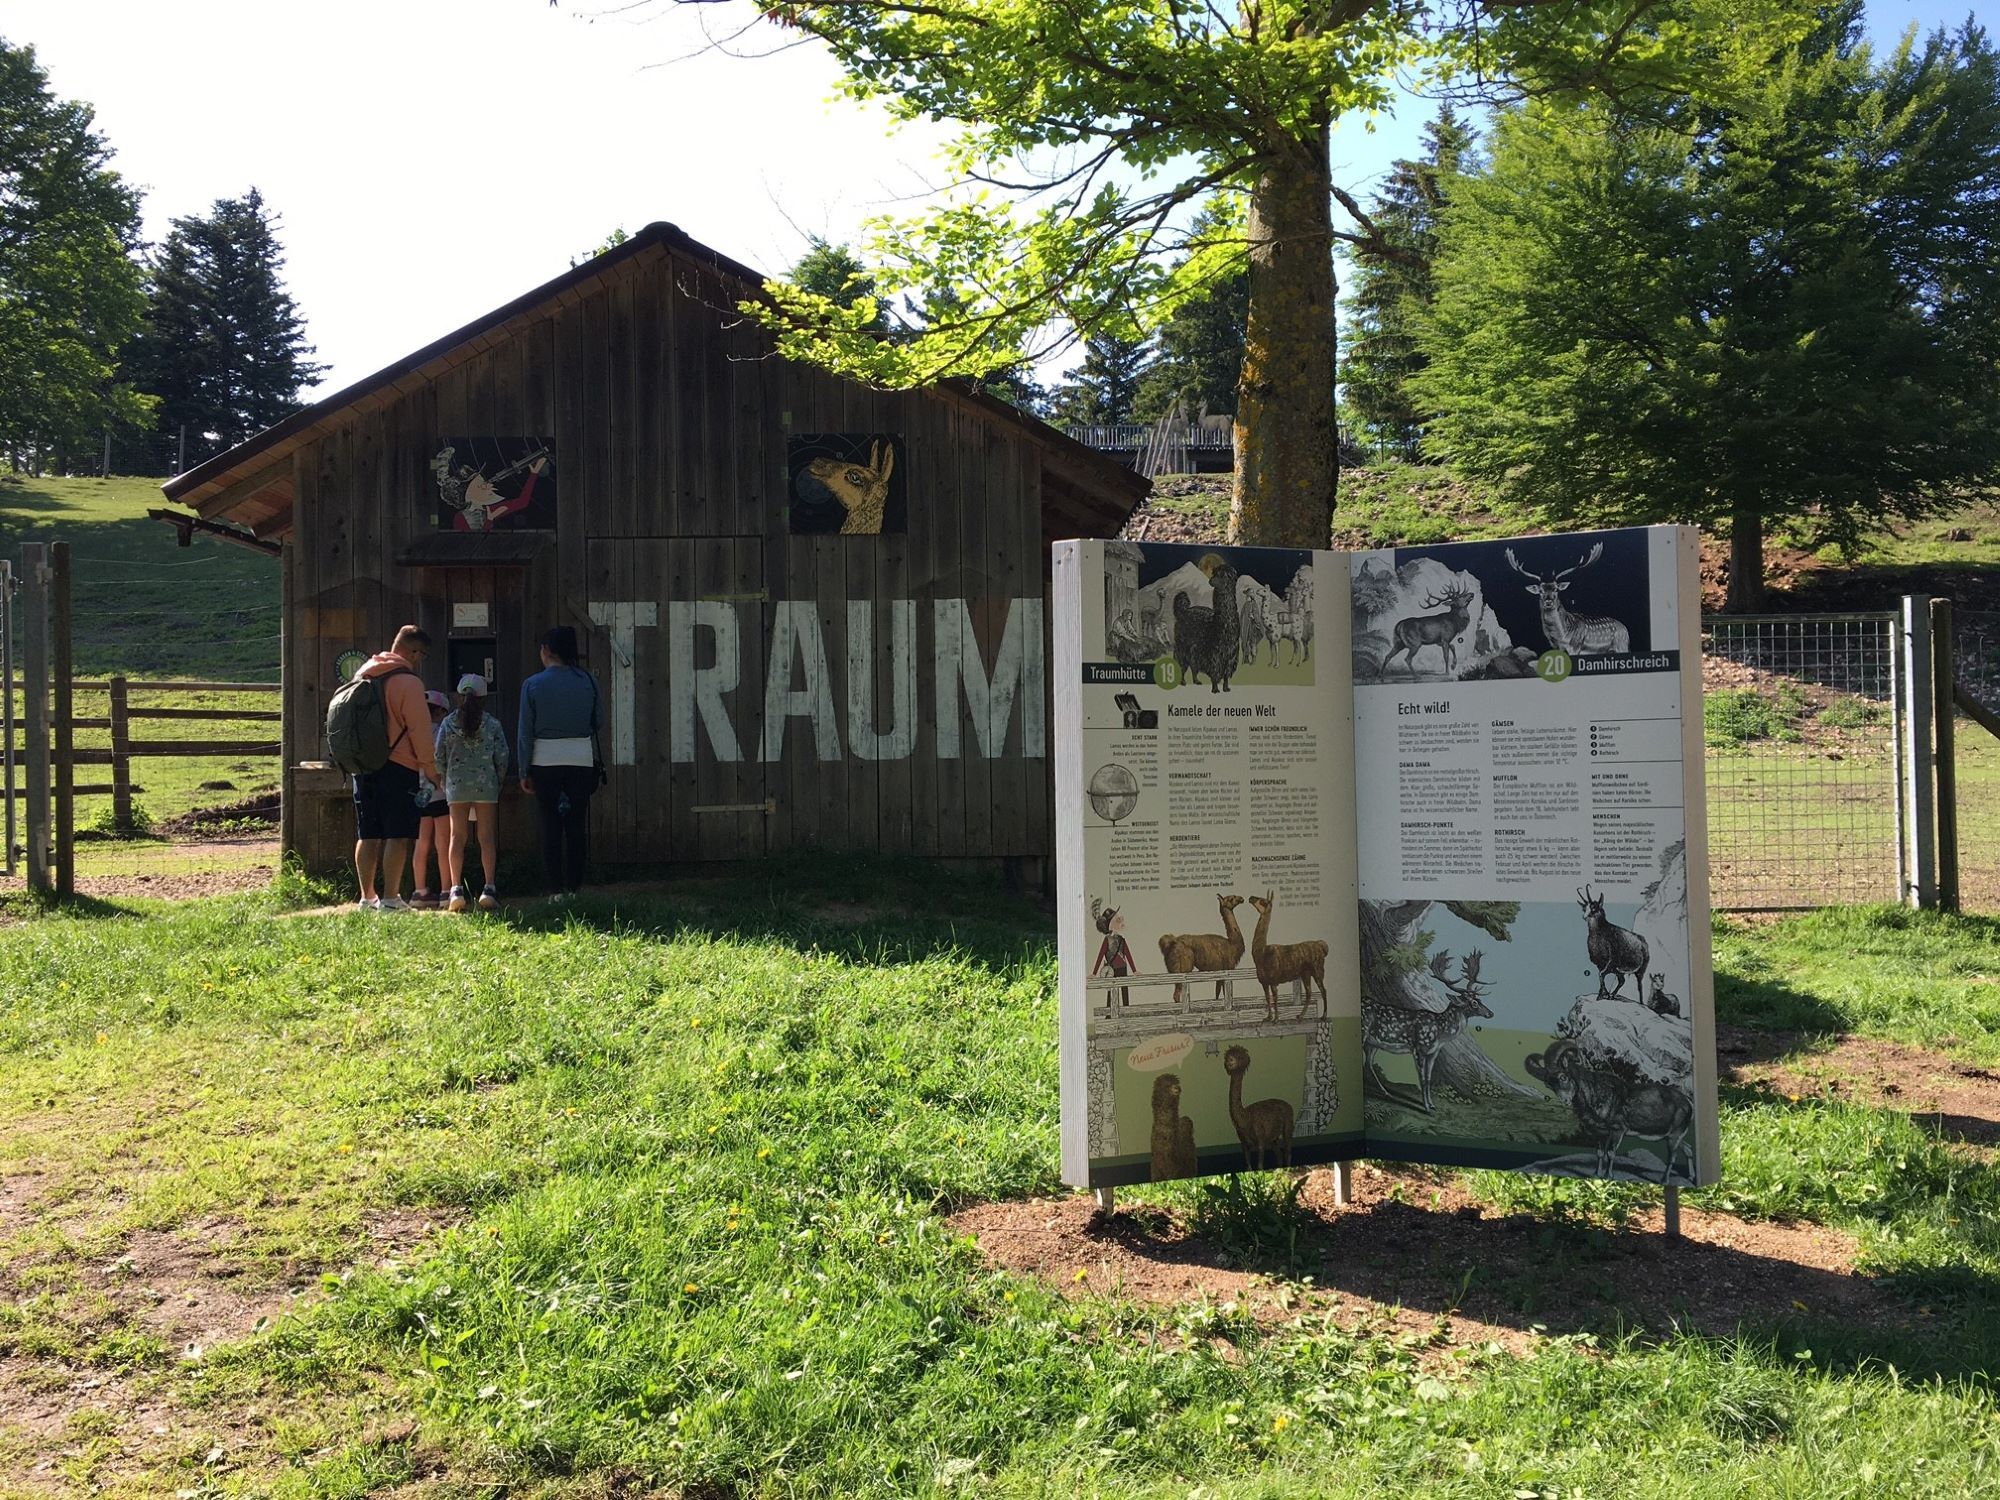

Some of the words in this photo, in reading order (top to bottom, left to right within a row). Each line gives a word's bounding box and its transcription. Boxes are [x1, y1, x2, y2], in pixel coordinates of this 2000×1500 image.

[1091, 666, 1146, 681] Traumhütte
[1161, 663, 1175, 683] 19
[1544, 656, 1565, 676] 20
[1578, 654, 1670, 672] Damhirschreich
[588, 597, 1046, 767] TRAUM
[1168, 704, 1202, 717] Kamele
[1206, 705, 1221, 717] der
[1224, 706, 1252, 717] neuen
[1255, 705, 1276, 717] Welt
[1398, 703, 1420, 715] Echt
[1424, 701, 1450, 713] wild!
